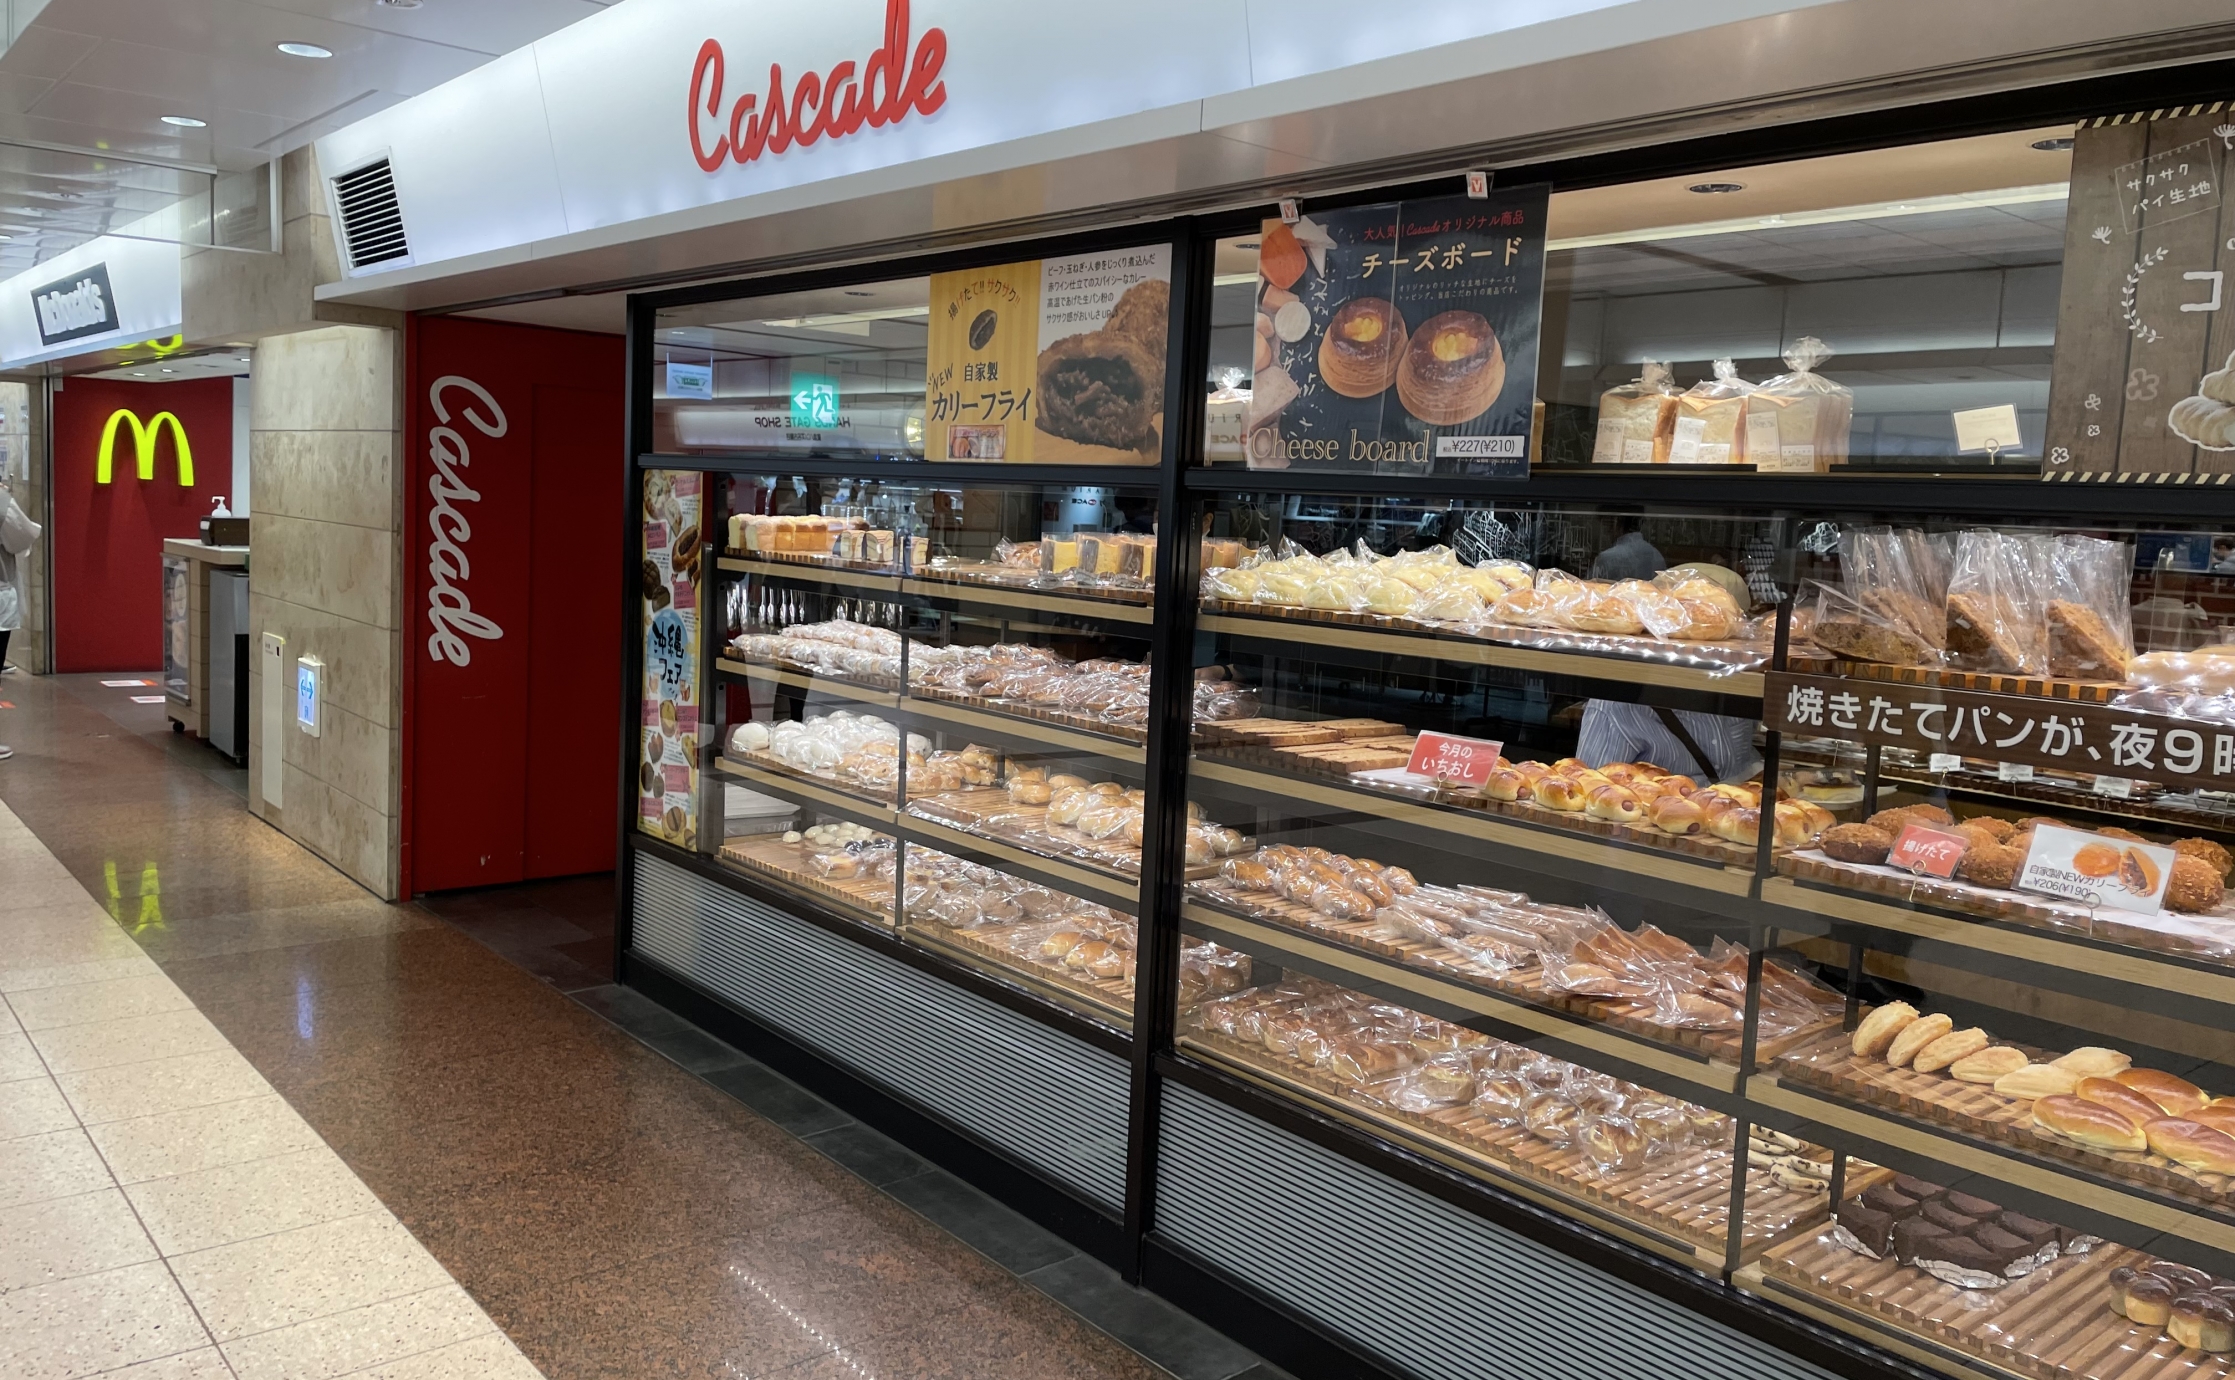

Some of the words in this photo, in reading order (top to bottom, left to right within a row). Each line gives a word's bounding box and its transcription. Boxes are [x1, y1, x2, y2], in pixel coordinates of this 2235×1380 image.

[688, 0, 948, 173] Cascade
[2127, 163, 2188, 191] サクサク
[2133, 181, 2211, 214] パイ生地
[1362, 237, 1522, 278] チーズボード
[932, 363, 954, 394] NEW
[964, 361, 998, 382] 自家製
[931, 387, 1032, 422] カリーフライ
[1251, 427, 1339, 460] Cheese
[1349, 428, 1430, 463] board
[428, 375, 508, 667] Cascade
[659, 658, 682, 684] フェア
[1439, 742, 1472, 758] 今月の
[1422, 757, 1473, 778] いちおし
